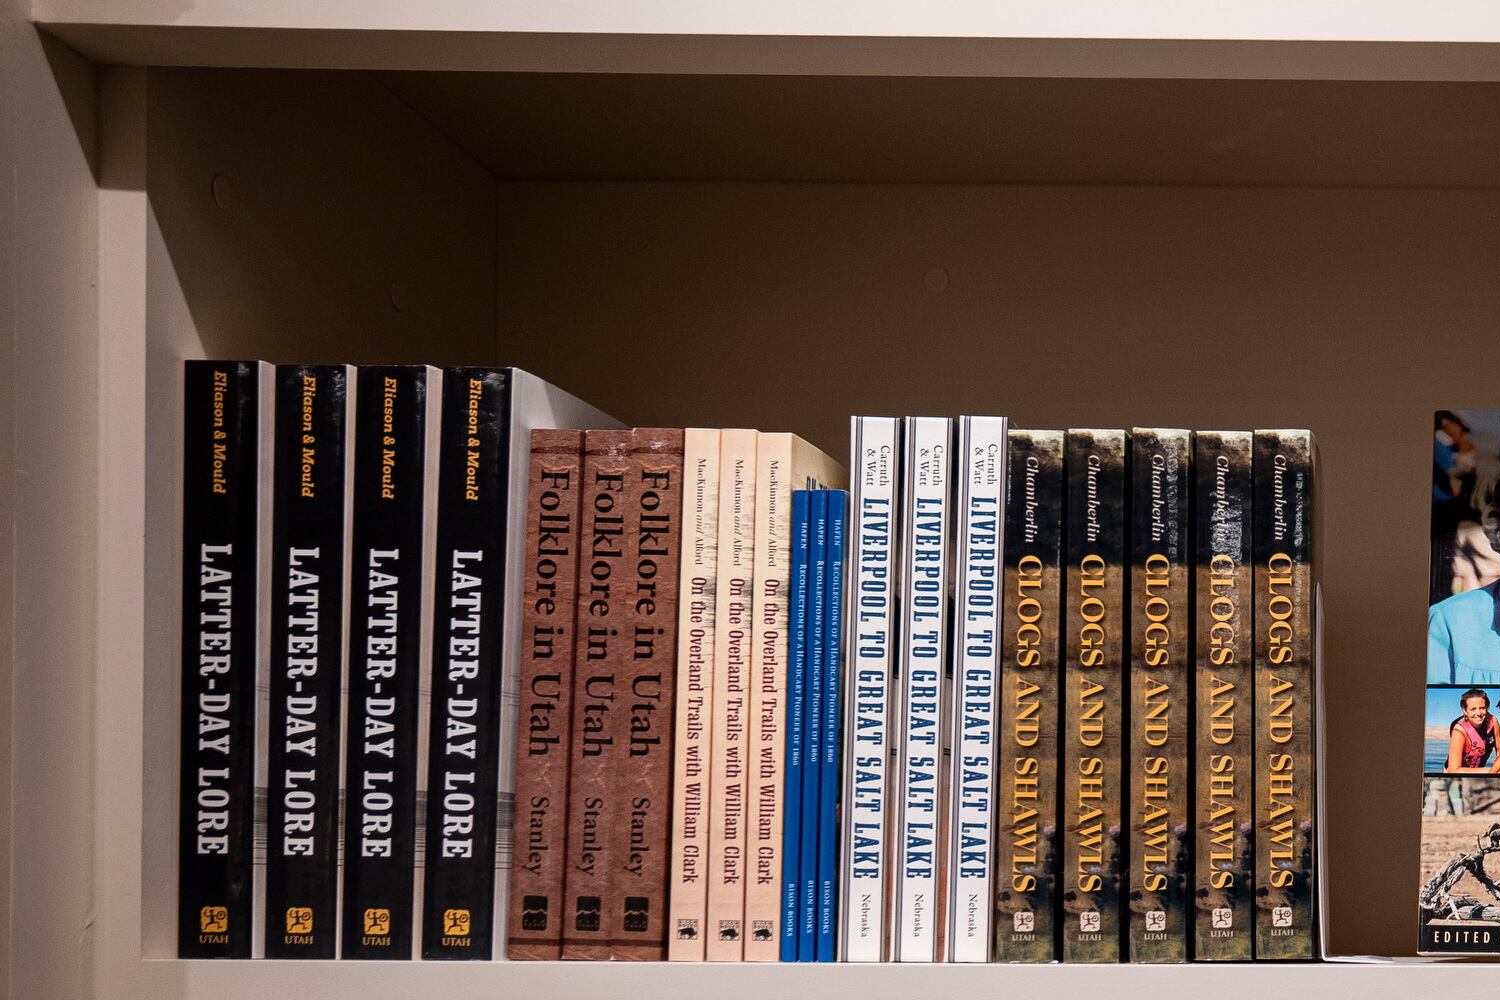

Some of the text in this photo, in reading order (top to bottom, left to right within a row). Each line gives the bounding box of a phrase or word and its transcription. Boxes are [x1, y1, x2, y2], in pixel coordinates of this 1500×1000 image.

[213, 371, 227, 494] Eliason & Mould
[866, 448, 877, 486] & Watt
[879, 445, 890, 486] Carruth
[695, 458, 707, 565] MacKinnon and Alford
[1025, 456, 1039, 542] Chamberlin
[528, 465, 573, 757] Folklore in Utah
[197, 543, 232, 854] LATTER-DAY LORE
[683, 577, 707, 883] On the Overland Trails with William Clark
[853, 498, 889, 881] LIVERPOOL TO GREAT SALT LAKE
[1010, 555, 1044, 894] CLOGS AND SHAWLS
[522, 796, 550, 876] Stanley
[199, 935, 229, 944] UTAH
[861, 894, 871, 937] Nebraska
[1011, 932, 1038, 943] UTAH
[1434, 931, 1490, 943] EDITED
